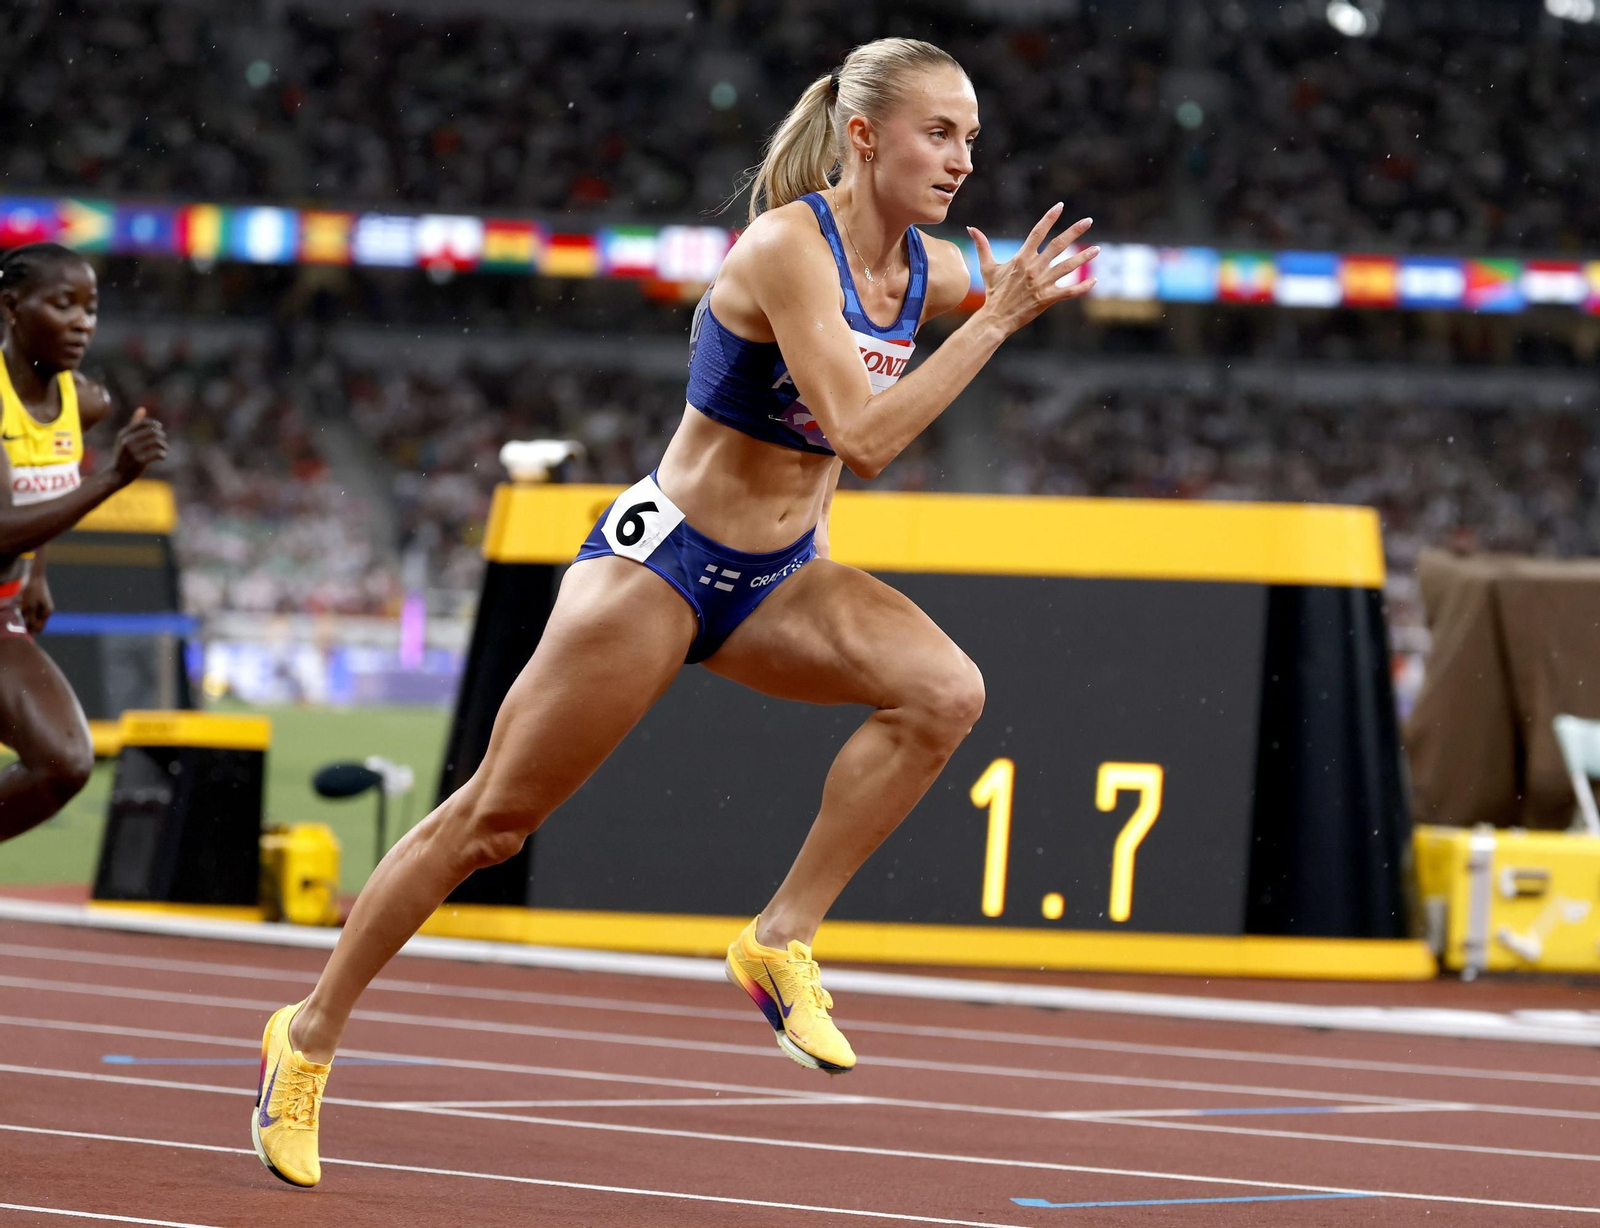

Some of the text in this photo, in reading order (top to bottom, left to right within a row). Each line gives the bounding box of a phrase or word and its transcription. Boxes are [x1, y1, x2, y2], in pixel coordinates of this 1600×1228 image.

[859, 346, 909, 377] ON
[13, 473, 77, 493] ONDA
[616, 501, 660, 547] 6
[750, 563, 791, 588] CRAFT
